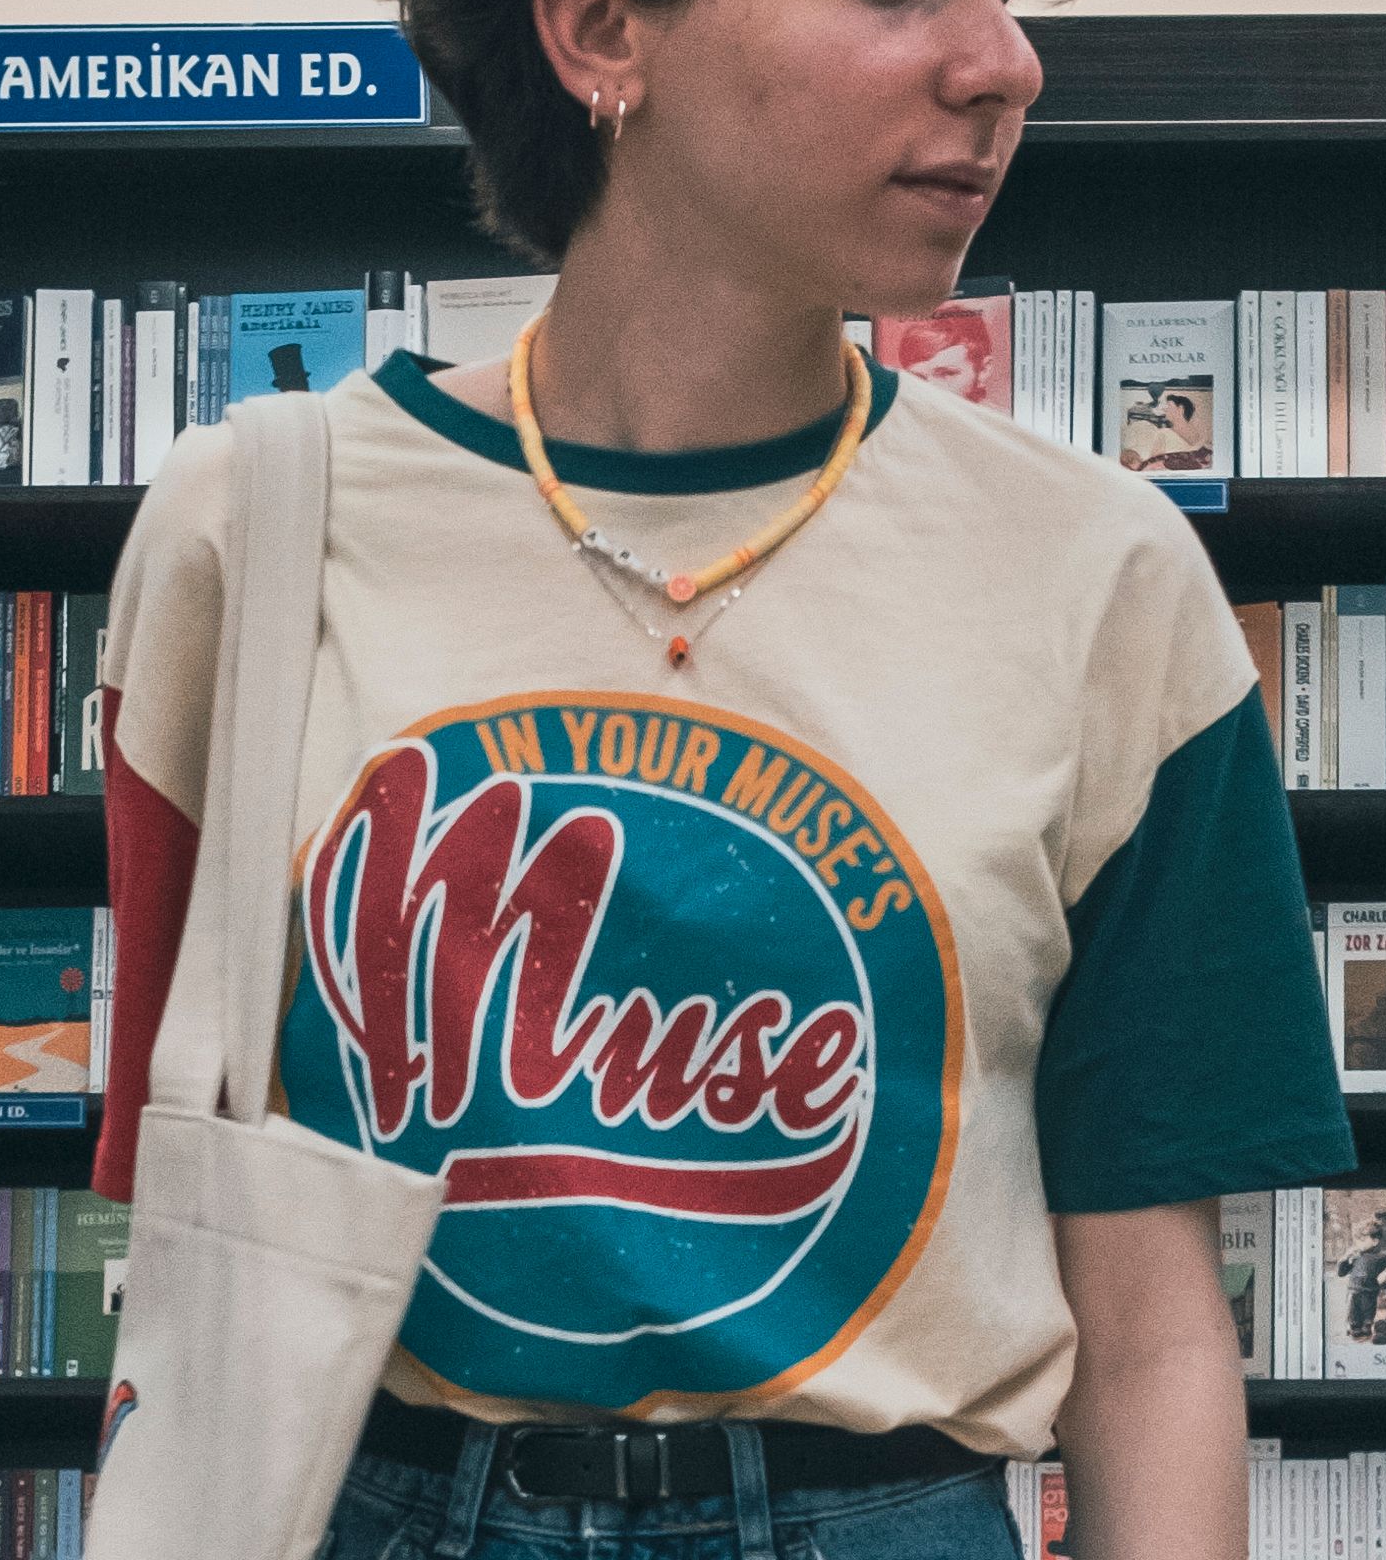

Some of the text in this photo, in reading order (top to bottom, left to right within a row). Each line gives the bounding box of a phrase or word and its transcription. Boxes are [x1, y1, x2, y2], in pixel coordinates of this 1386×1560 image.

[300, 53, 379, 97] ED.
[240, 300, 356, 317] HENRY JAMES
[240, 317, 322, 332] amerikalı
[1128, 352, 1206, 366] KADINLAR
[474, 711, 915, 933] IN YOUR MUSE'S
[305, 737, 875, 1140] Muse
[1345, 934, 1370, 952] ZOR
[7, 1104, 31, 1119] ED.
